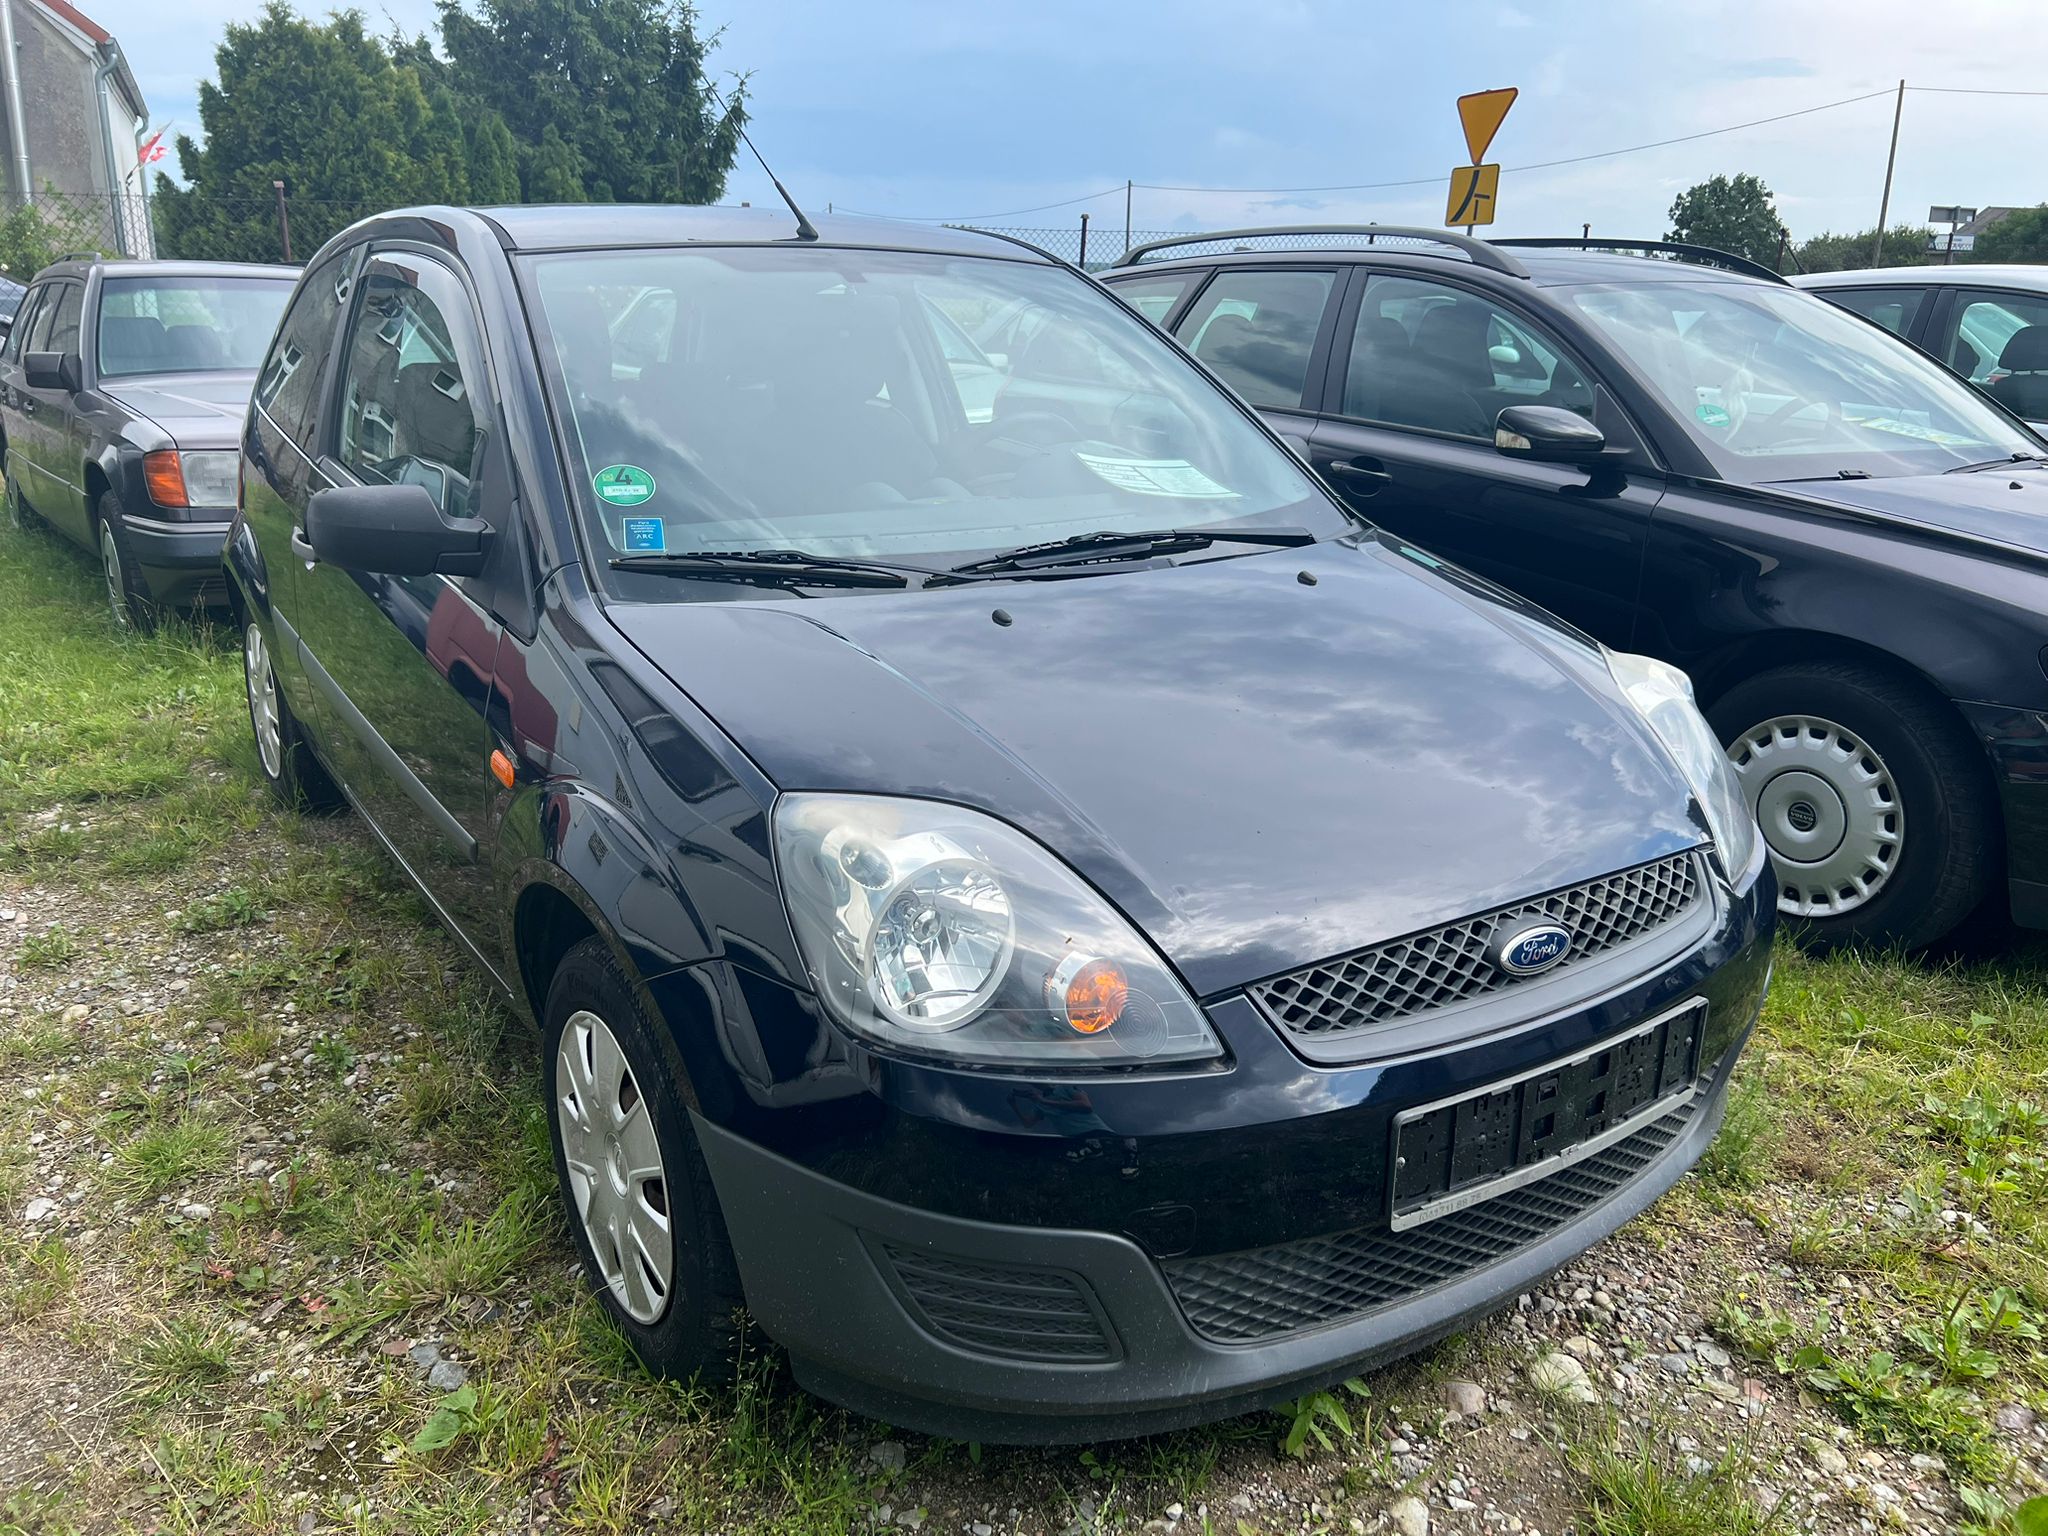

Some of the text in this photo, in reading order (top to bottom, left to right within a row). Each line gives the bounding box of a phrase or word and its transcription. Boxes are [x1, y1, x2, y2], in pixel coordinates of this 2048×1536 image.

[615, 467, 632, 485] 4
[1790, 811, 1814, 822] VOLVO
[1521, 934, 1559, 964] Ford
